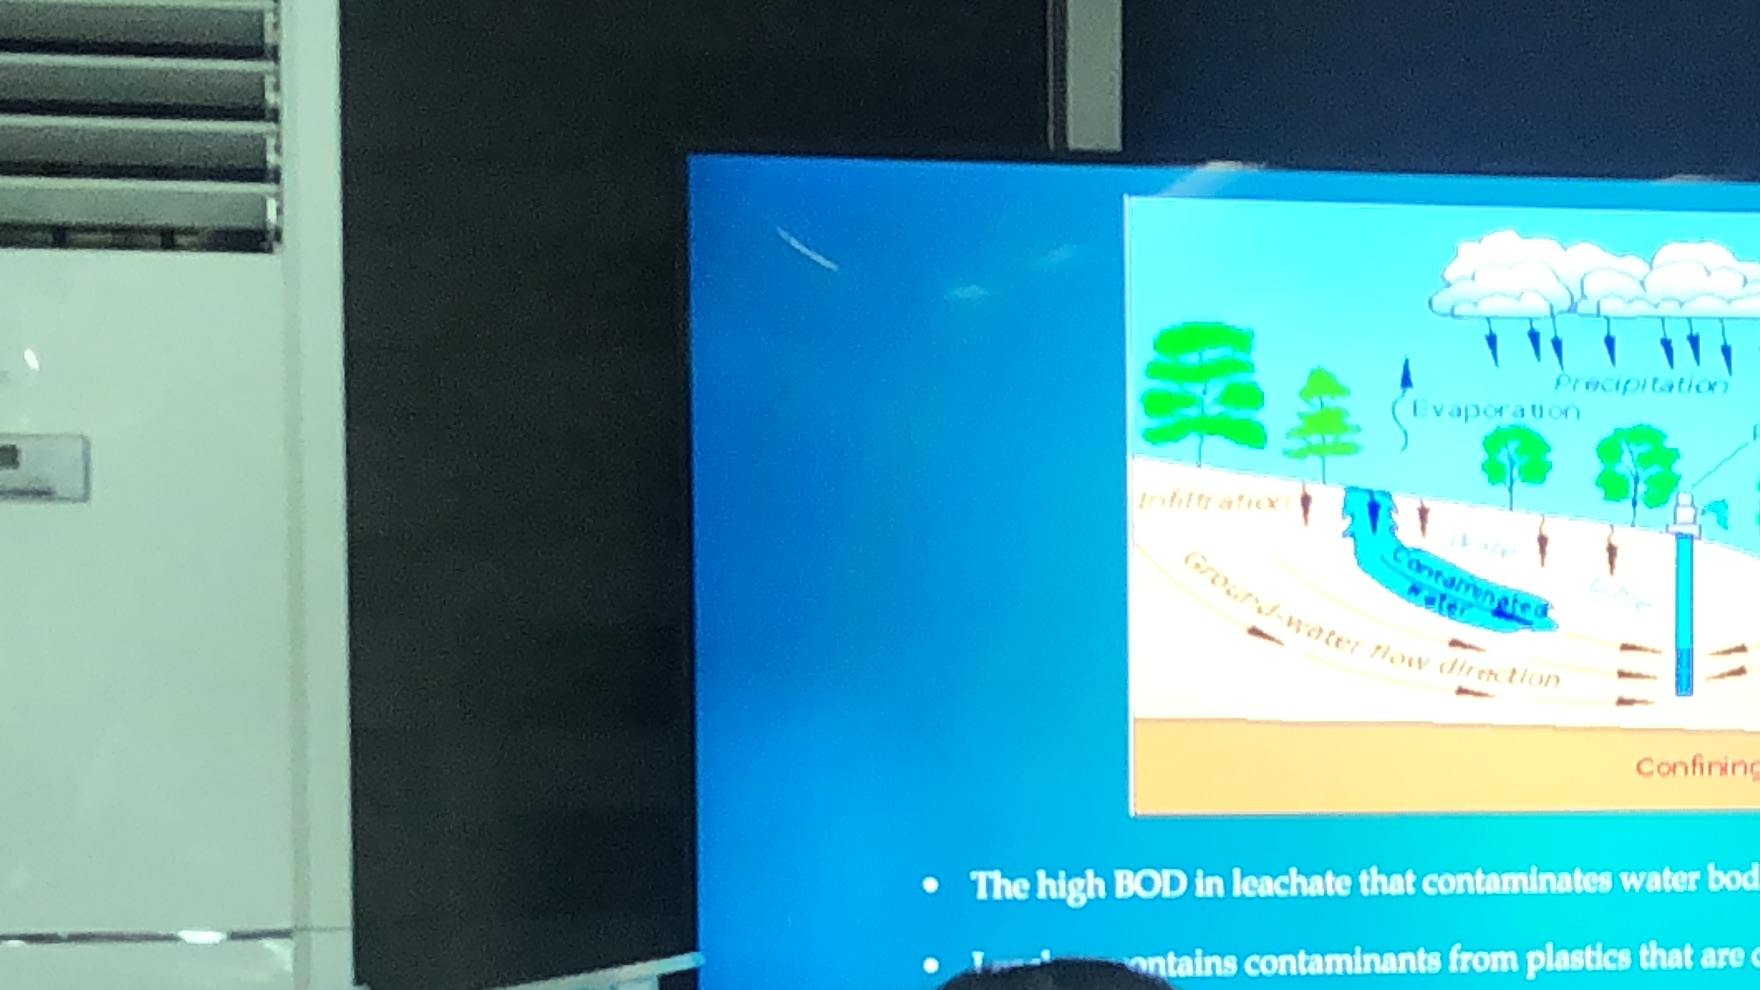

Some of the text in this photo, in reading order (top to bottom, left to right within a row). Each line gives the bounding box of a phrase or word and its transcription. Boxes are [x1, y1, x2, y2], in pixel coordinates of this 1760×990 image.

[1554, 372, 1730, 397] Precipitation
[1412, 400, 1580, 424] Evaporation
[1371, 638, 1430, 676] flow
[1438, 657, 1561, 690] direction
[969, 868, 1030, 901] The
[1035, 868, 1107, 909] high
[1113, 867, 1189, 899] BOD
[1193, 868, 1225, 898] in
[1231, 866, 1353, 898] leachate
[1357, 864, 1417, 897] that
[1420, 864, 1613, 896] contaminates
[1618, 865, 1701, 893] water
[1124, 948, 1239, 979] ontains
[1243, 945, 1443, 977] contaminants
[1447, 942, 1520, 974] from
[1525, 941, 1633, 981] plastics
[1638, 939, 1695, 971] that
[1699, 946, 1746, 969] are
